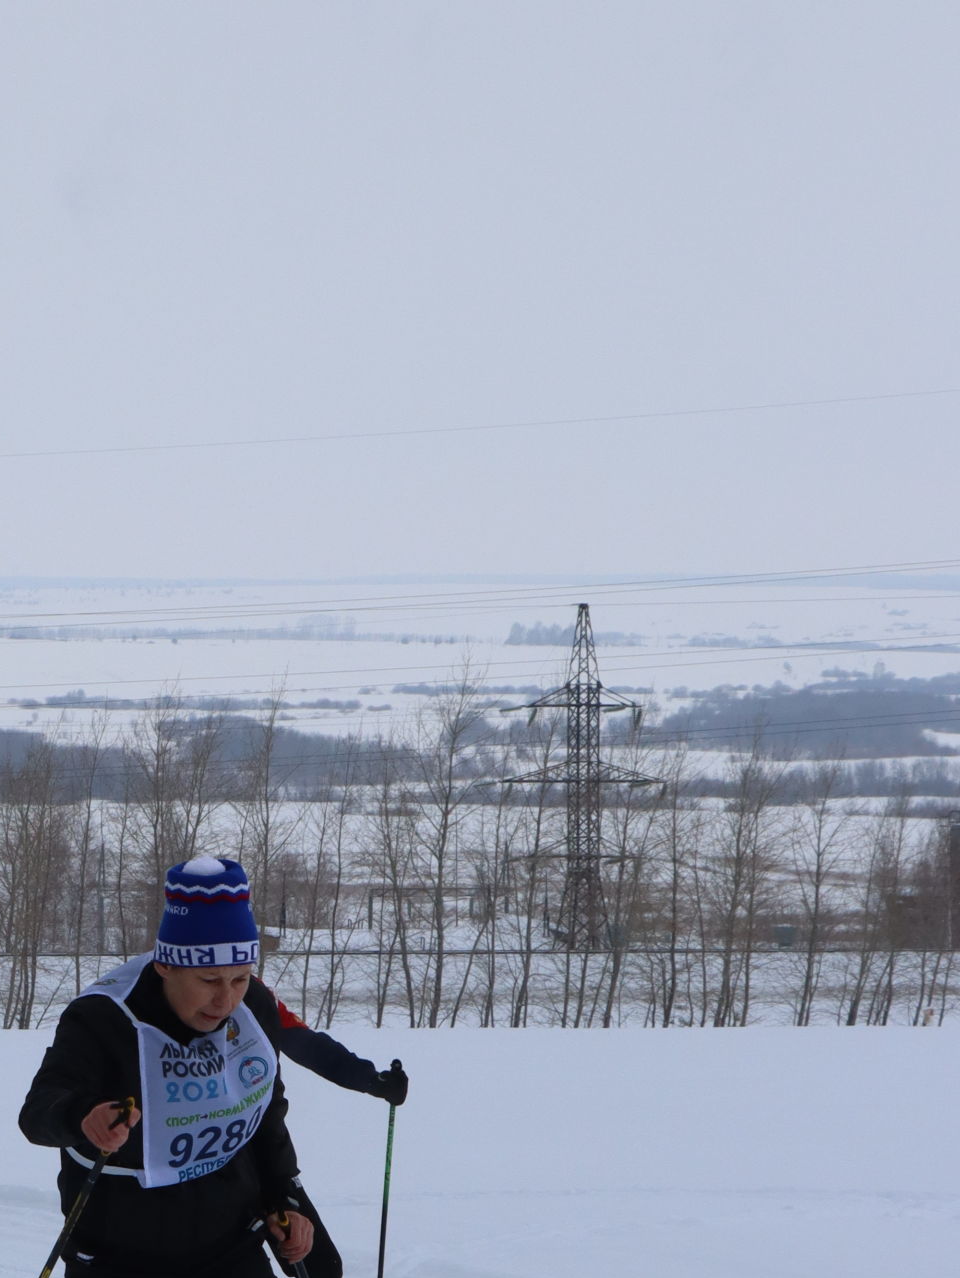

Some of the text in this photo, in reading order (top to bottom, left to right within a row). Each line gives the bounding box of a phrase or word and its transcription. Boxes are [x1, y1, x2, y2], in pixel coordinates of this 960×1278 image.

[162, 1054, 225, 1078] РОССИИ
[166, 1077, 228, 1103] 2021
[166, 1113, 200, 1127] СПОРТ
[208, 1102, 246, 1119] НОРМА
[168, 1105, 262, 1168] 9280
